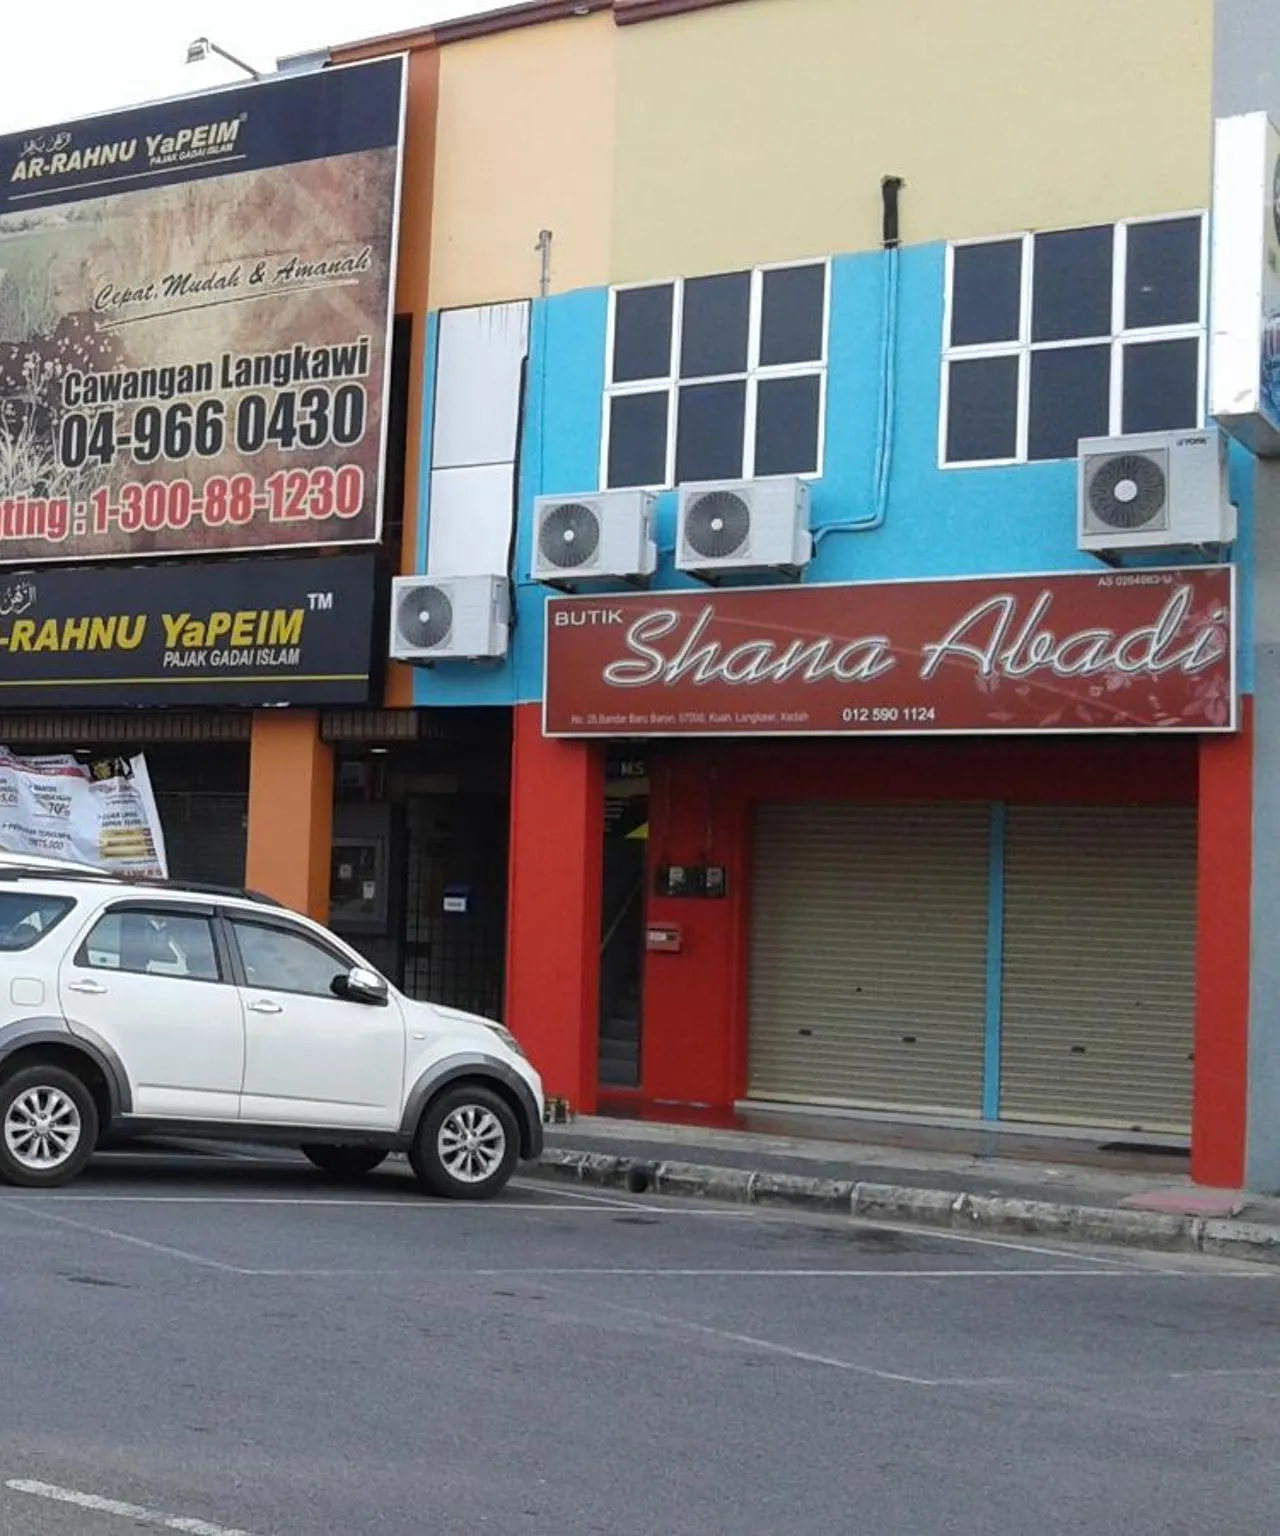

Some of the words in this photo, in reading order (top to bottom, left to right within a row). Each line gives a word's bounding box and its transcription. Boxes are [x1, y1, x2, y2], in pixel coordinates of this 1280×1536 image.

[10, 137, 138, 183] AR-RAHNU
[145, 118, 240, 157] YaPEIM
[149, 152, 178, 168] PAJAK
[179, 149, 206, 161] GADAI
[162, 265, 241, 298] Mudah
[248, 260, 267, 285] &
[272, 246, 373, 284] Amanah
[63, 360, 214, 407] Cawangan
[220, 337, 369, 393] Langkawi
[60, 398, 224, 469] 04-966
[235, 383, 366, 454] 0430
[91, 464, 365, 533] 1-300-88-1230
[161, 608, 305, 650] YaPEIM
[307, 592, 333, 610] TM
[553, 608, 624, 626] BUTIK
[602, 604, 897, 688] Shana
[918, 583, 1228, 680] Abadi
[163, 651, 207, 668] PAJAK
[208, 649, 253, 667] GADAI
[255, 648, 300, 666] ISLAM
[842, 708, 868, 722] 012
[872, 708, 899, 722] 590
[903, 707, 936, 721] 1124
